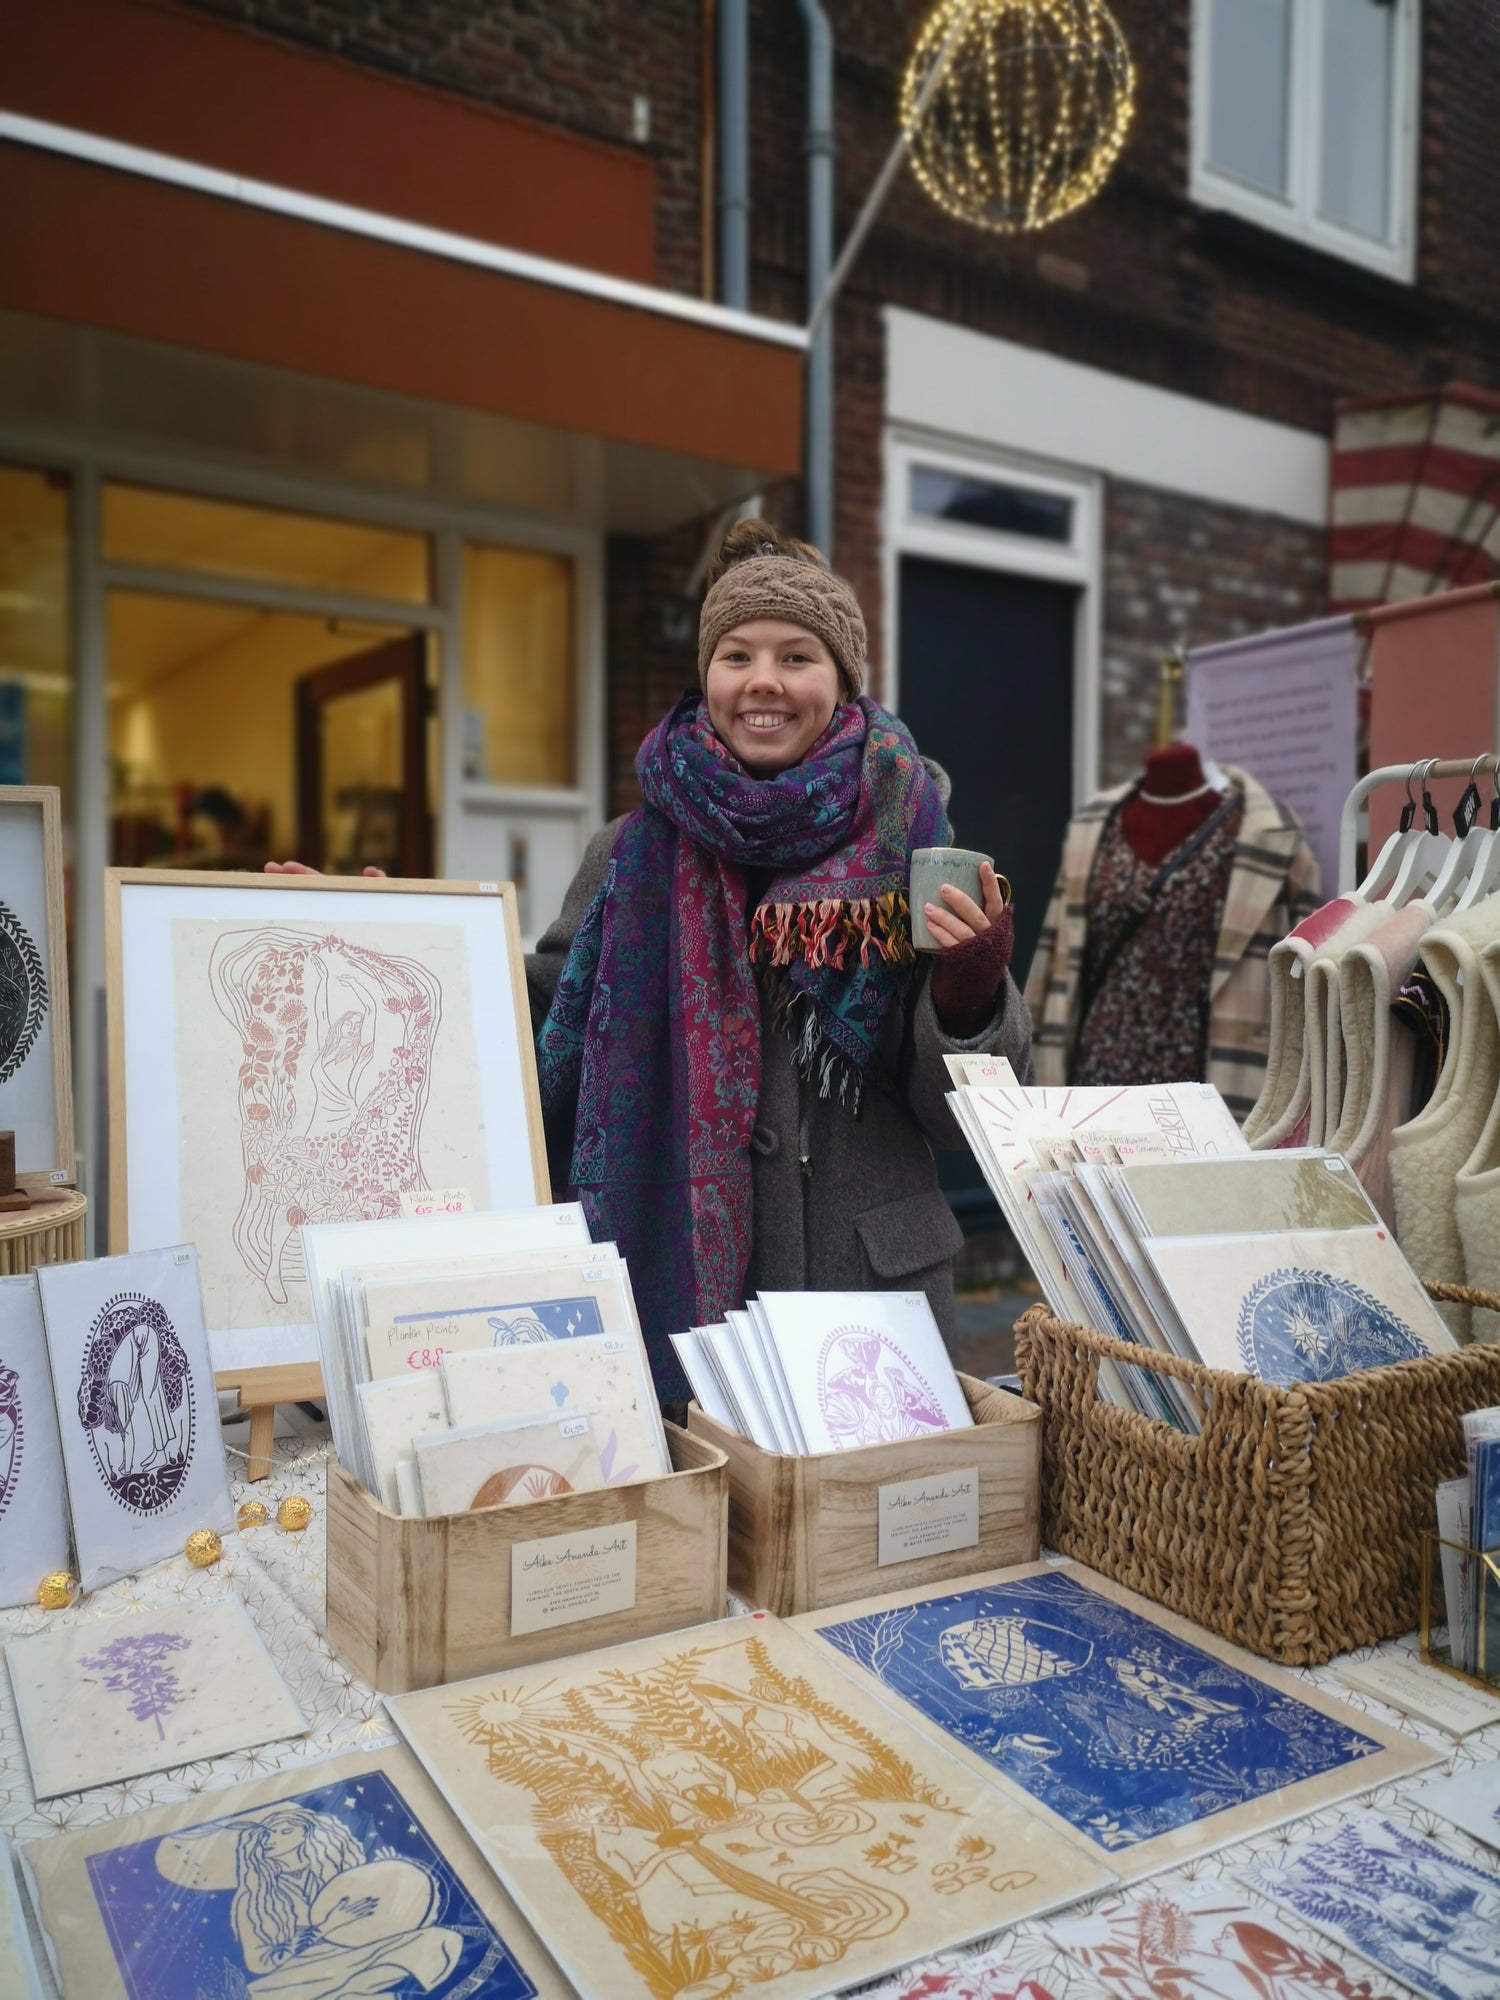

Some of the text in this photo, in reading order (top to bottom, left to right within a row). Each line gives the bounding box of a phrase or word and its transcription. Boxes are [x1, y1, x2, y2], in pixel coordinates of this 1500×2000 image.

[407, 1347, 454, 1370] €8,8
[888, 1483, 972, 1510] Aike Ananda Art
[522, 1538, 628, 1570] Aike Ananda Art
